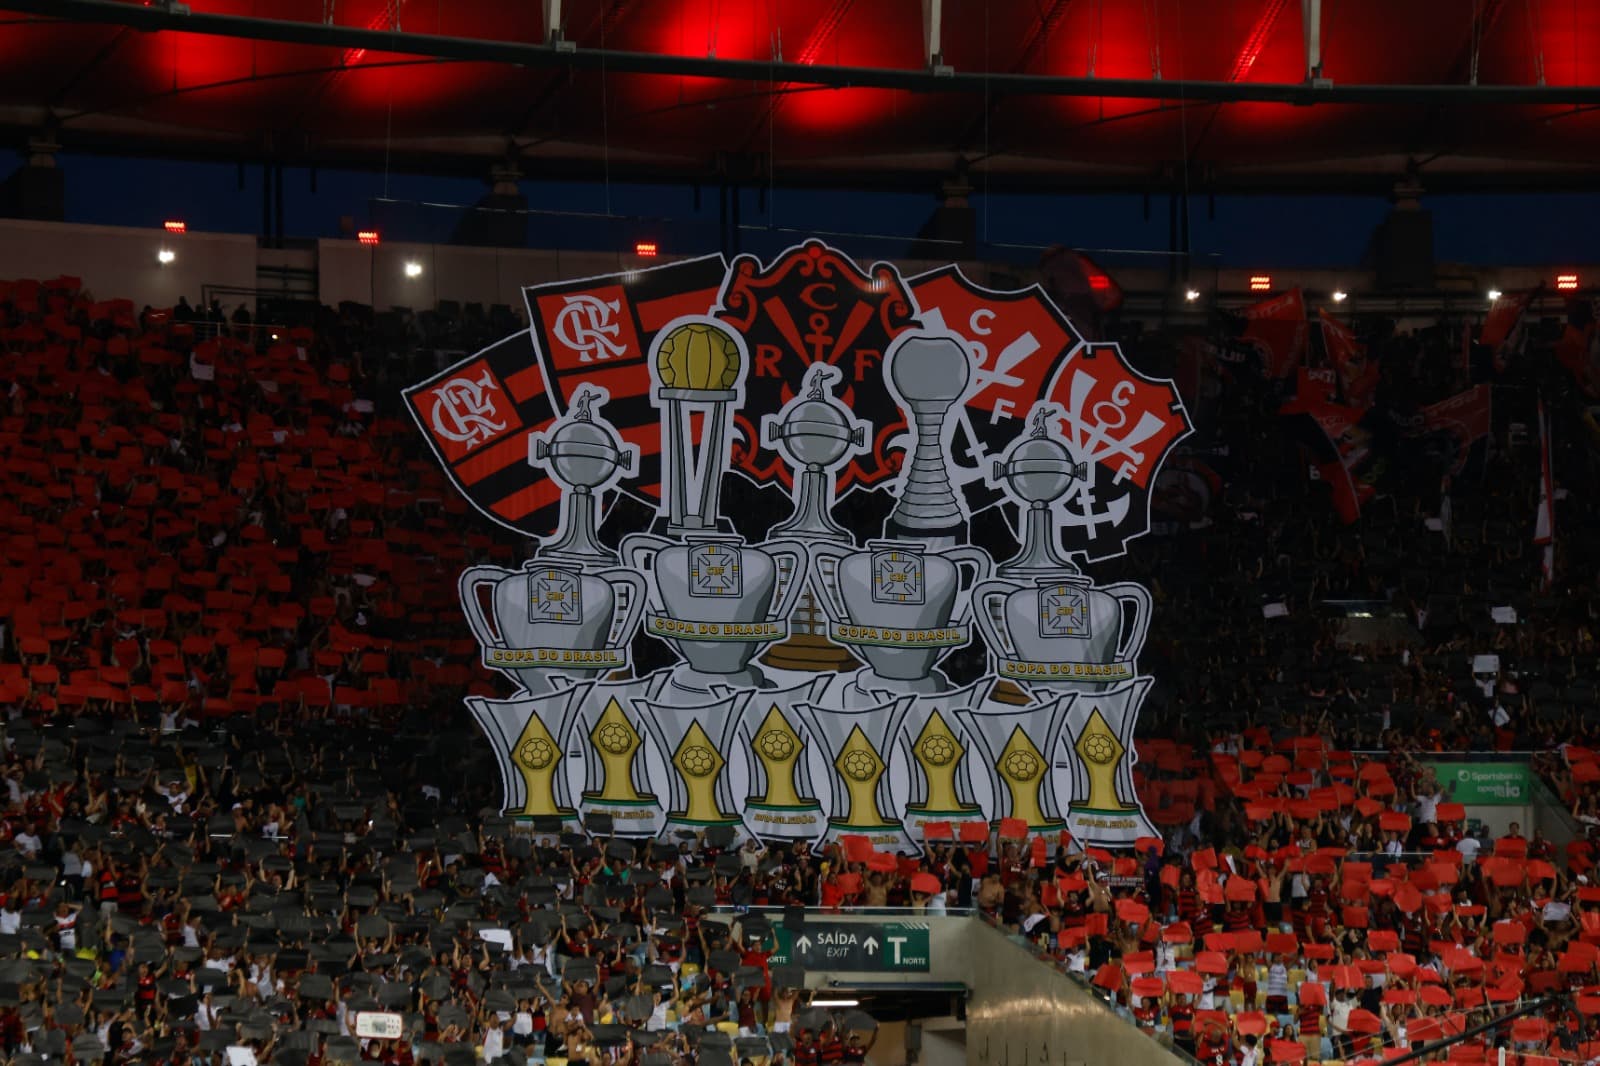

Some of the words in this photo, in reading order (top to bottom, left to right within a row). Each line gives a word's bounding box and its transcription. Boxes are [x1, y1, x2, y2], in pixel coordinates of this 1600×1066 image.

[754, 343, 784, 379] R
[854, 349, 883, 382] F
[989, 397, 1016, 425] F
[1111, 459, 1138, 487] F
[655, 618, 695, 634] COPA
[698, 623, 719, 635] DO
[723, 623, 778, 635] BRASIL
[839, 625, 878, 640] COPA
[881, 629, 901, 641] DO
[906, 628, 960, 641] BRASIL
[493, 649, 534, 661] COPA
[538, 649, 558, 660] DO
[562, 650, 617, 661] BRASIL
[1006, 661, 1047, 675] COPA
[1049, 663, 1070, 675] DO
[1073, 663, 1126, 676] BRASIL
[817, 930, 858, 946] SAÍDA
[826, 947, 849, 958] EXIT
[887, 936, 908, 965] T
[902, 957, 926, 966] NORTE
